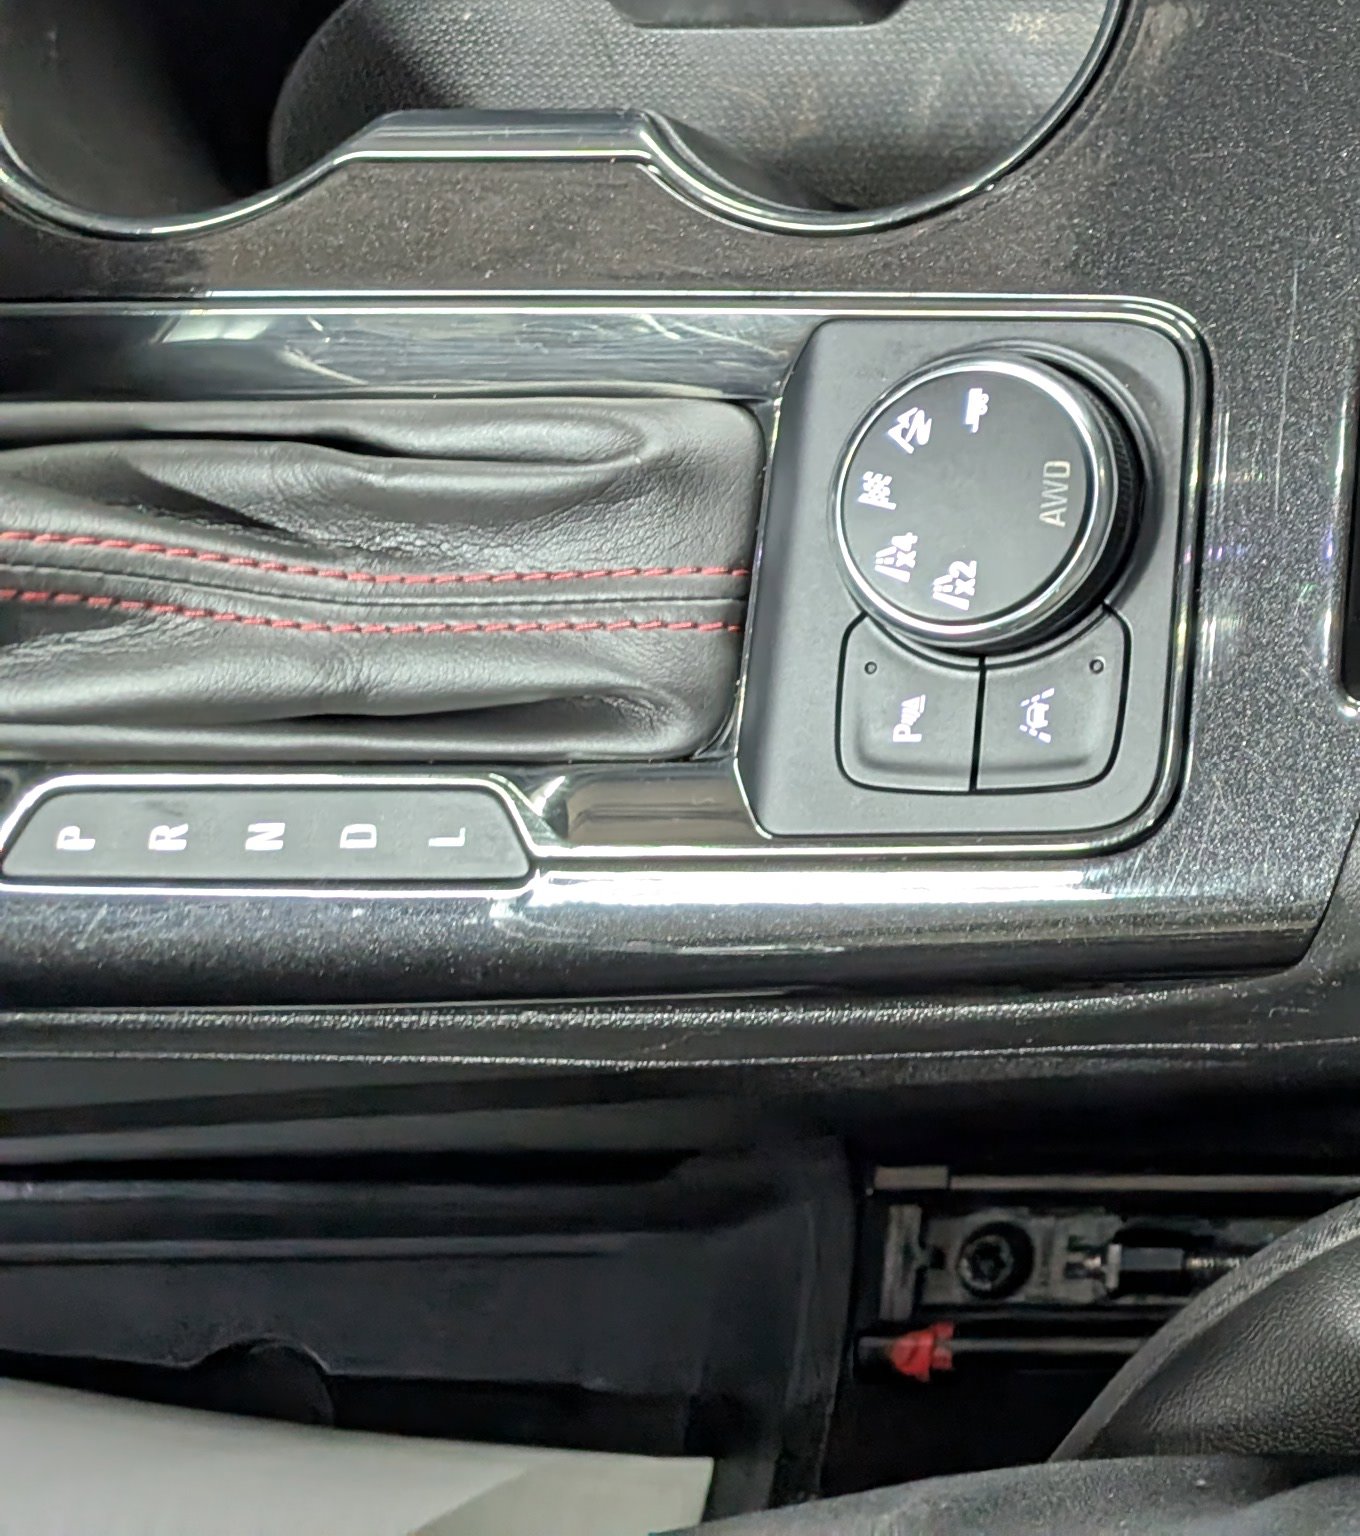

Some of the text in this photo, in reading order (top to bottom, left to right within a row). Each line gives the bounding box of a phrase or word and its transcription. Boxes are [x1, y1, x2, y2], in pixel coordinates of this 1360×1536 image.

[1039, 461, 1071, 527] AWD
[56, 825, 96, 851] P
[148, 823, 189, 851] R
[245, 822, 286, 851] N
[339, 823, 378, 849] D
[428, 827, 466, 848] L
